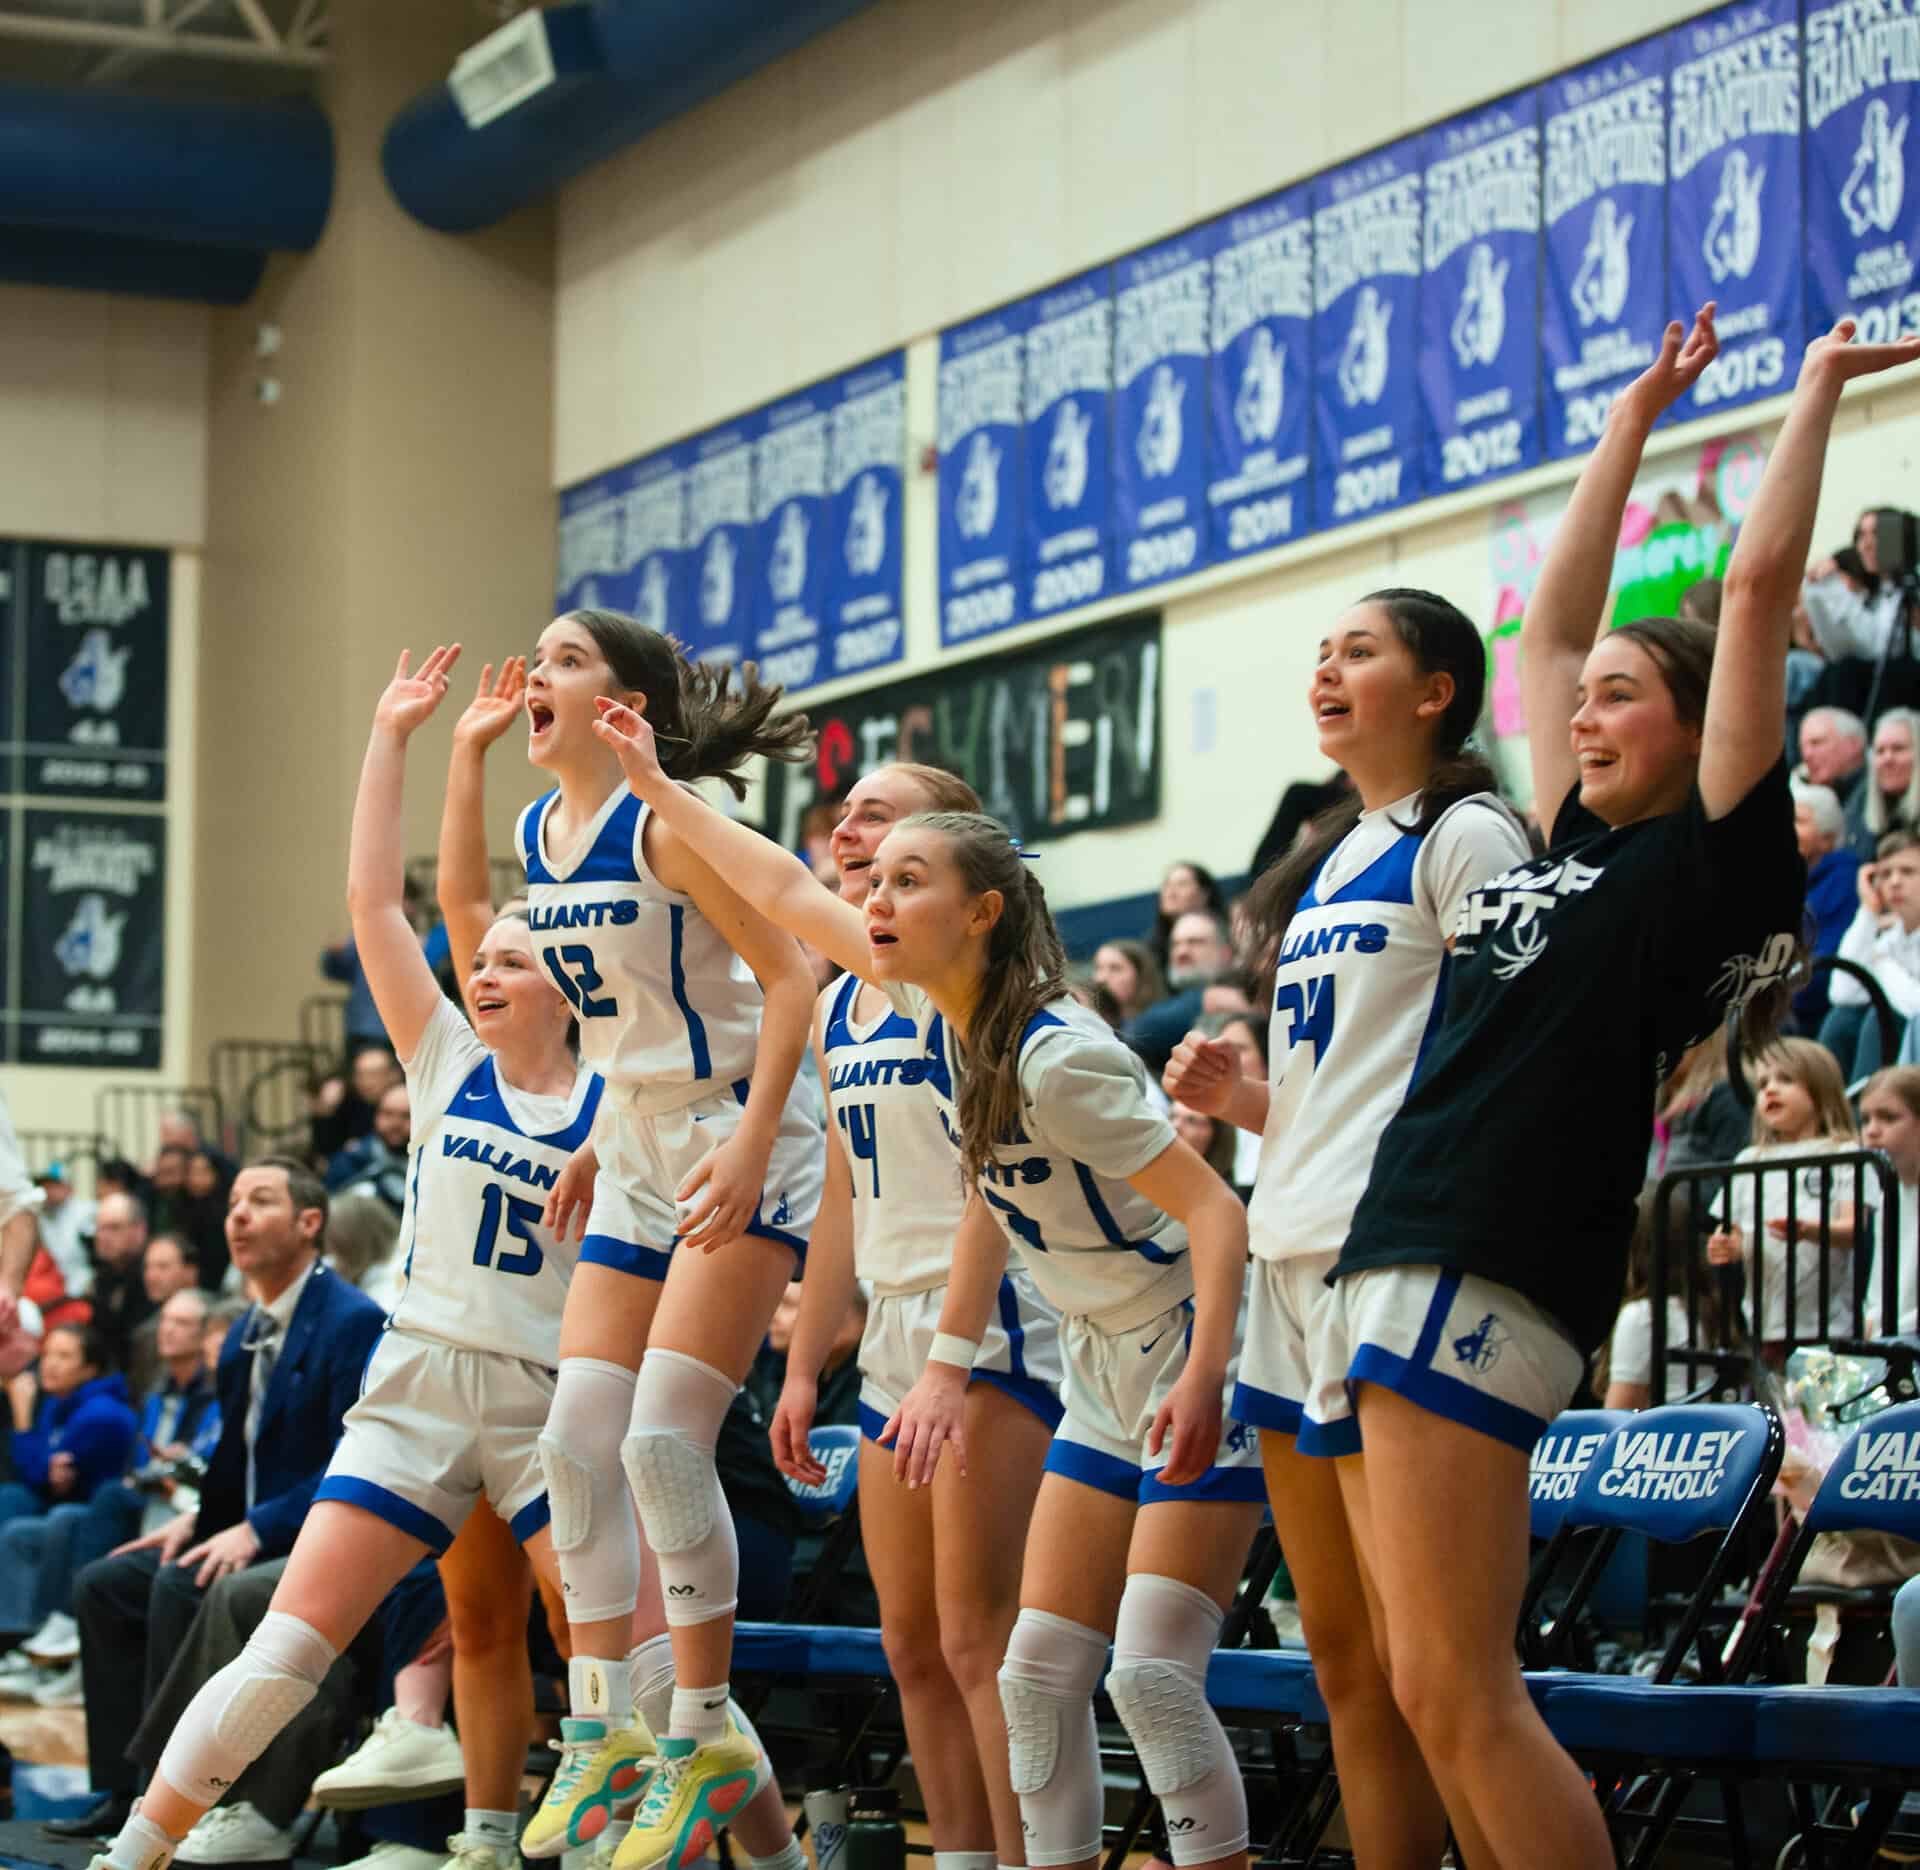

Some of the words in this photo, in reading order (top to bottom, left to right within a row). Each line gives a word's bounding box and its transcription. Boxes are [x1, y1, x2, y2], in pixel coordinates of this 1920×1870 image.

[1672, 23, 1799, 101] STATE
[1546, 76, 1666, 149] STATE
[1671, 68, 1799, 181] CHAMPIONS
[1424, 126, 1540, 194] STATE
[1840, 292, 1920, 345] 013
[1692, 337, 1785, 407] 2013
[1564, 386, 1610, 445] 20
[1442, 420, 1523, 482] 2012
[1334, 456, 1402, 517] 2011
[529, 899, 640, 932] LIANTS
[1277, 923, 1390, 968] LIANTS
[542, 944, 619, 1018] 12
[829, 1058, 927, 1093] LIANTS
[442, 1133, 560, 1191] VALIAN
[472, 1182, 545, 1277] 15
[1529, 1433, 1607, 1472] LLE
[1611, 1430, 1747, 1472] VALLEY
[1854, 1432, 1920, 1472] VAL
[1528, 1471, 1581, 1501] THOL
[1598, 1468, 1725, 1501] CATHOLIC
[1839, 1471, 1920, 1500] CATH
